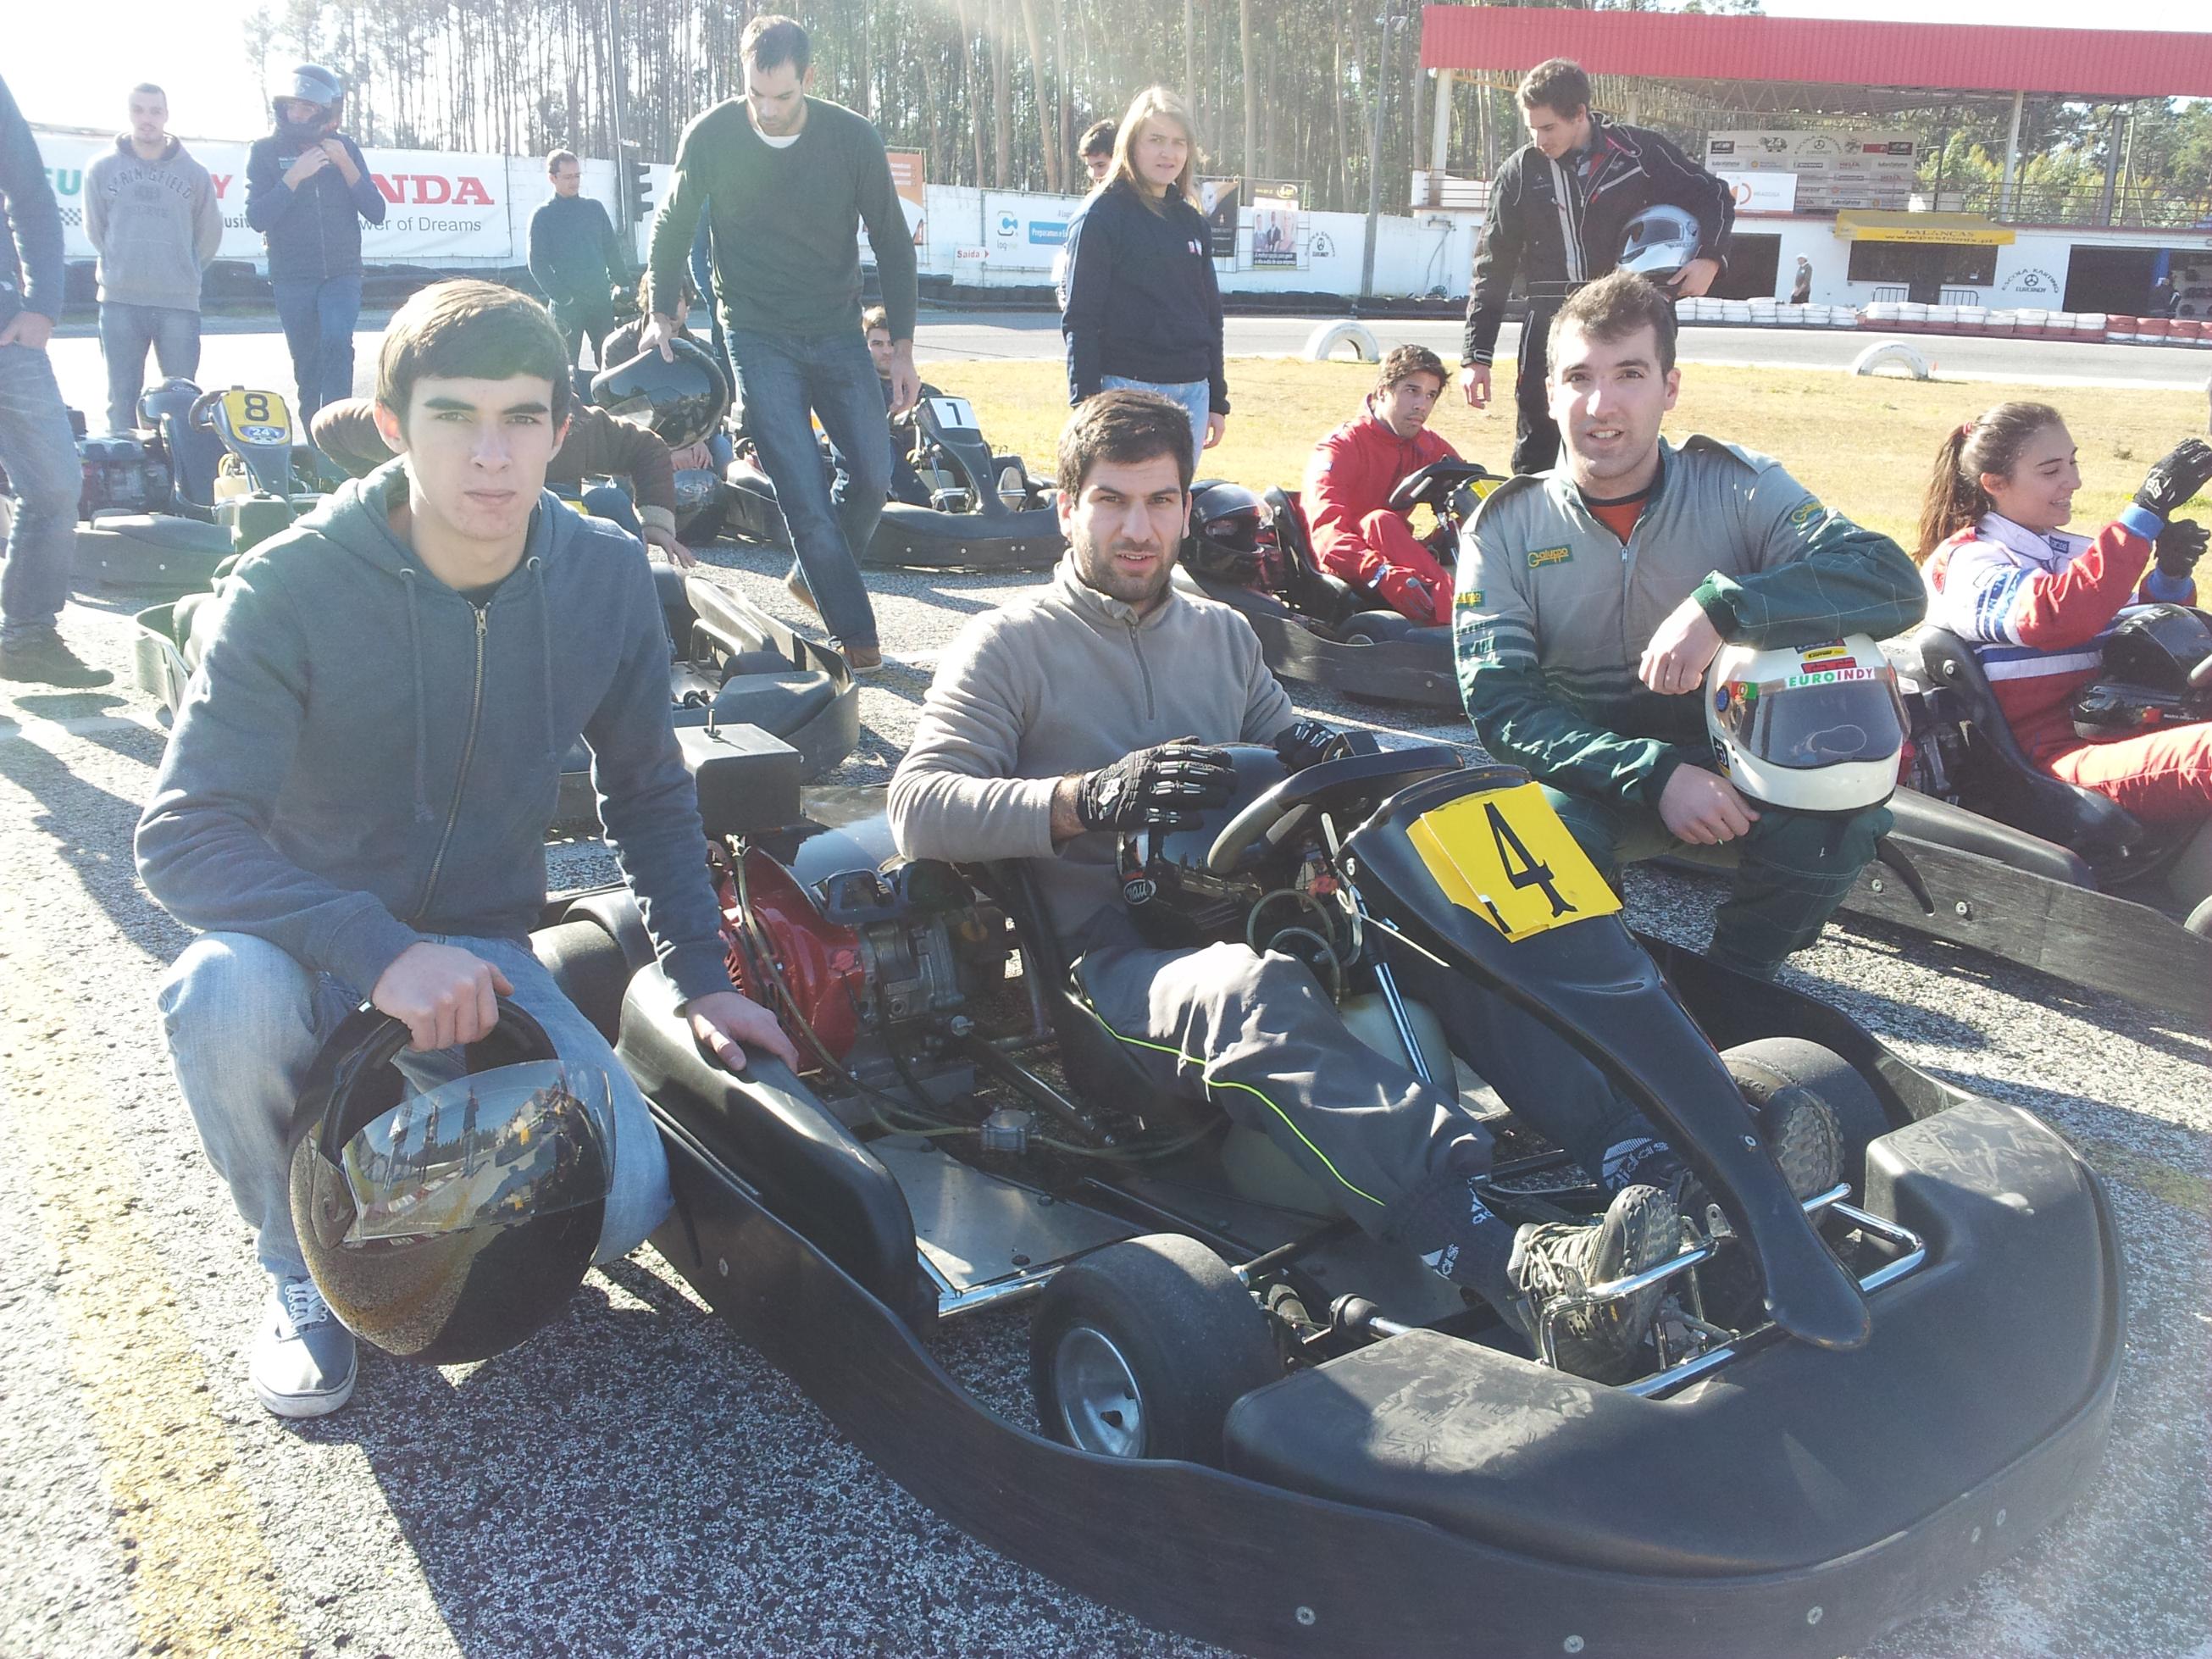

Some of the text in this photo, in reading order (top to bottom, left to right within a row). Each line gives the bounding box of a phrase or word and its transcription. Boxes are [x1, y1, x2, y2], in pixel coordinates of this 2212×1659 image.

[398, 217, 413, 231] of
[419, 218, 482, 232] Dreams
[244, 393, 269, 421] 8
[1788, 668, 1873, 688] EUROINDY
[1483, 801, 1578, 918] 4
